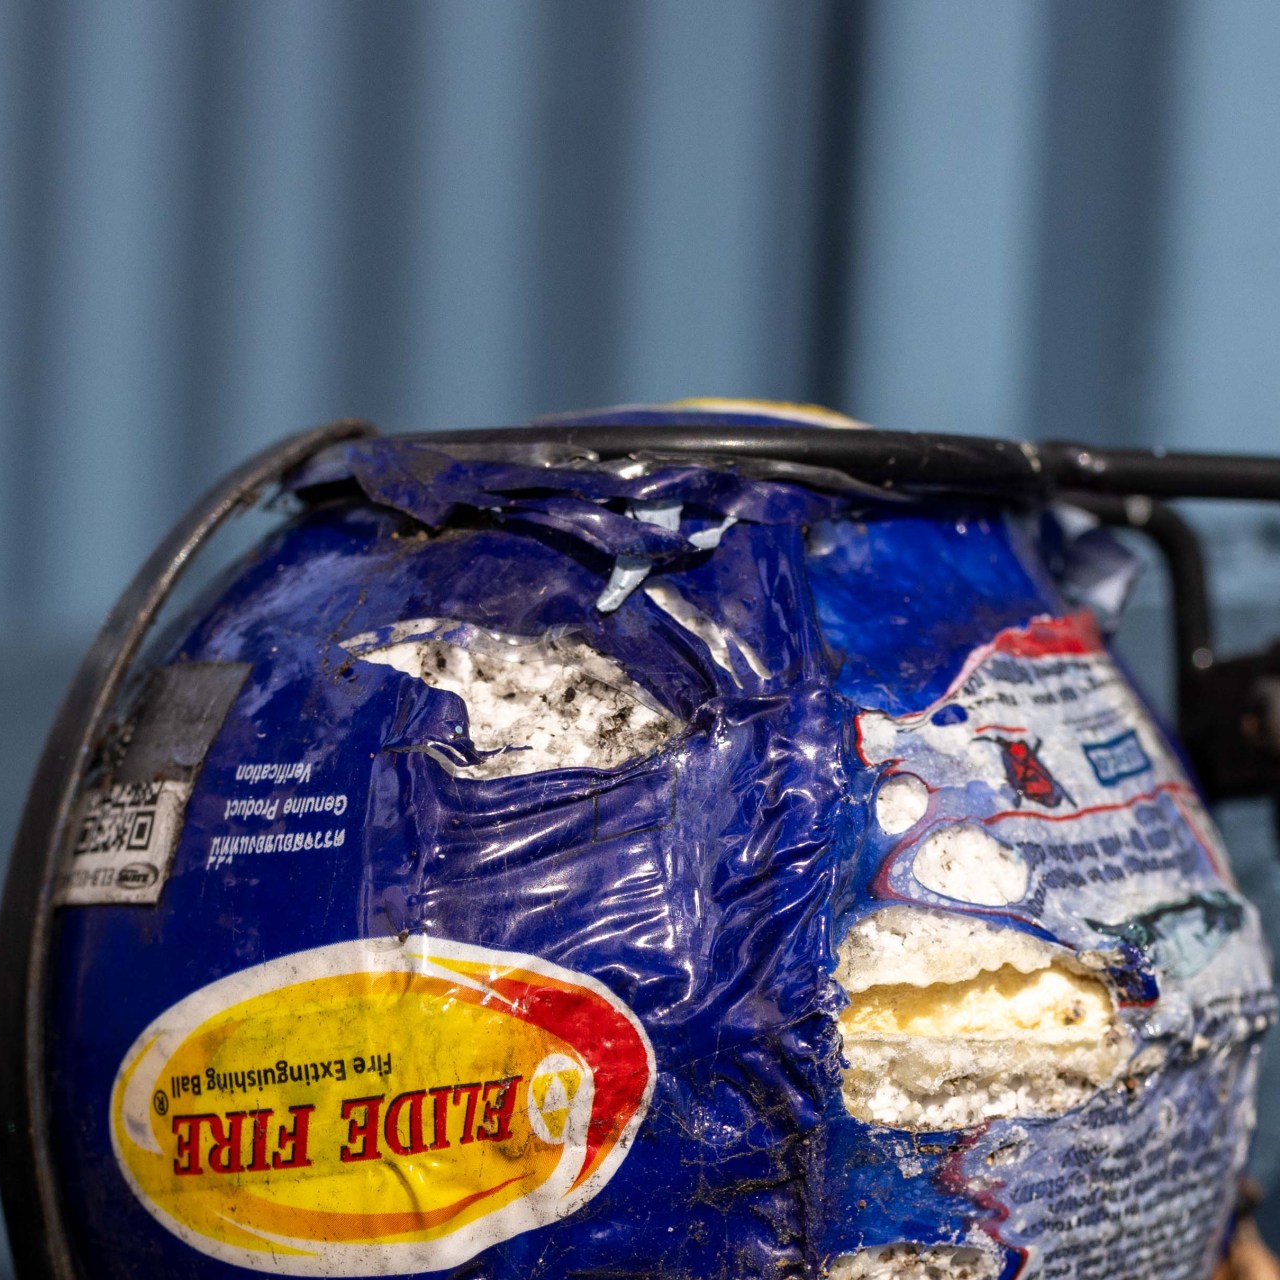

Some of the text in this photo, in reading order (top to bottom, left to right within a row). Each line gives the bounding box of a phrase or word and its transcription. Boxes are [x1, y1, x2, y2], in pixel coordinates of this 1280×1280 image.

[236, 762, 311, 784] Verification
[224, 794, 347, 820] Genuine Product
[206, 828, 346, 870] ตรวจสอบของแท้ที่นี่
[205, 1059, 345, 1093] Extinguishing
[352, 1051, 393, 1075] Fire
[170, 1074, 201, 1097] Ball
[172, 1076, 522, 1175] ELIDE FIRE
